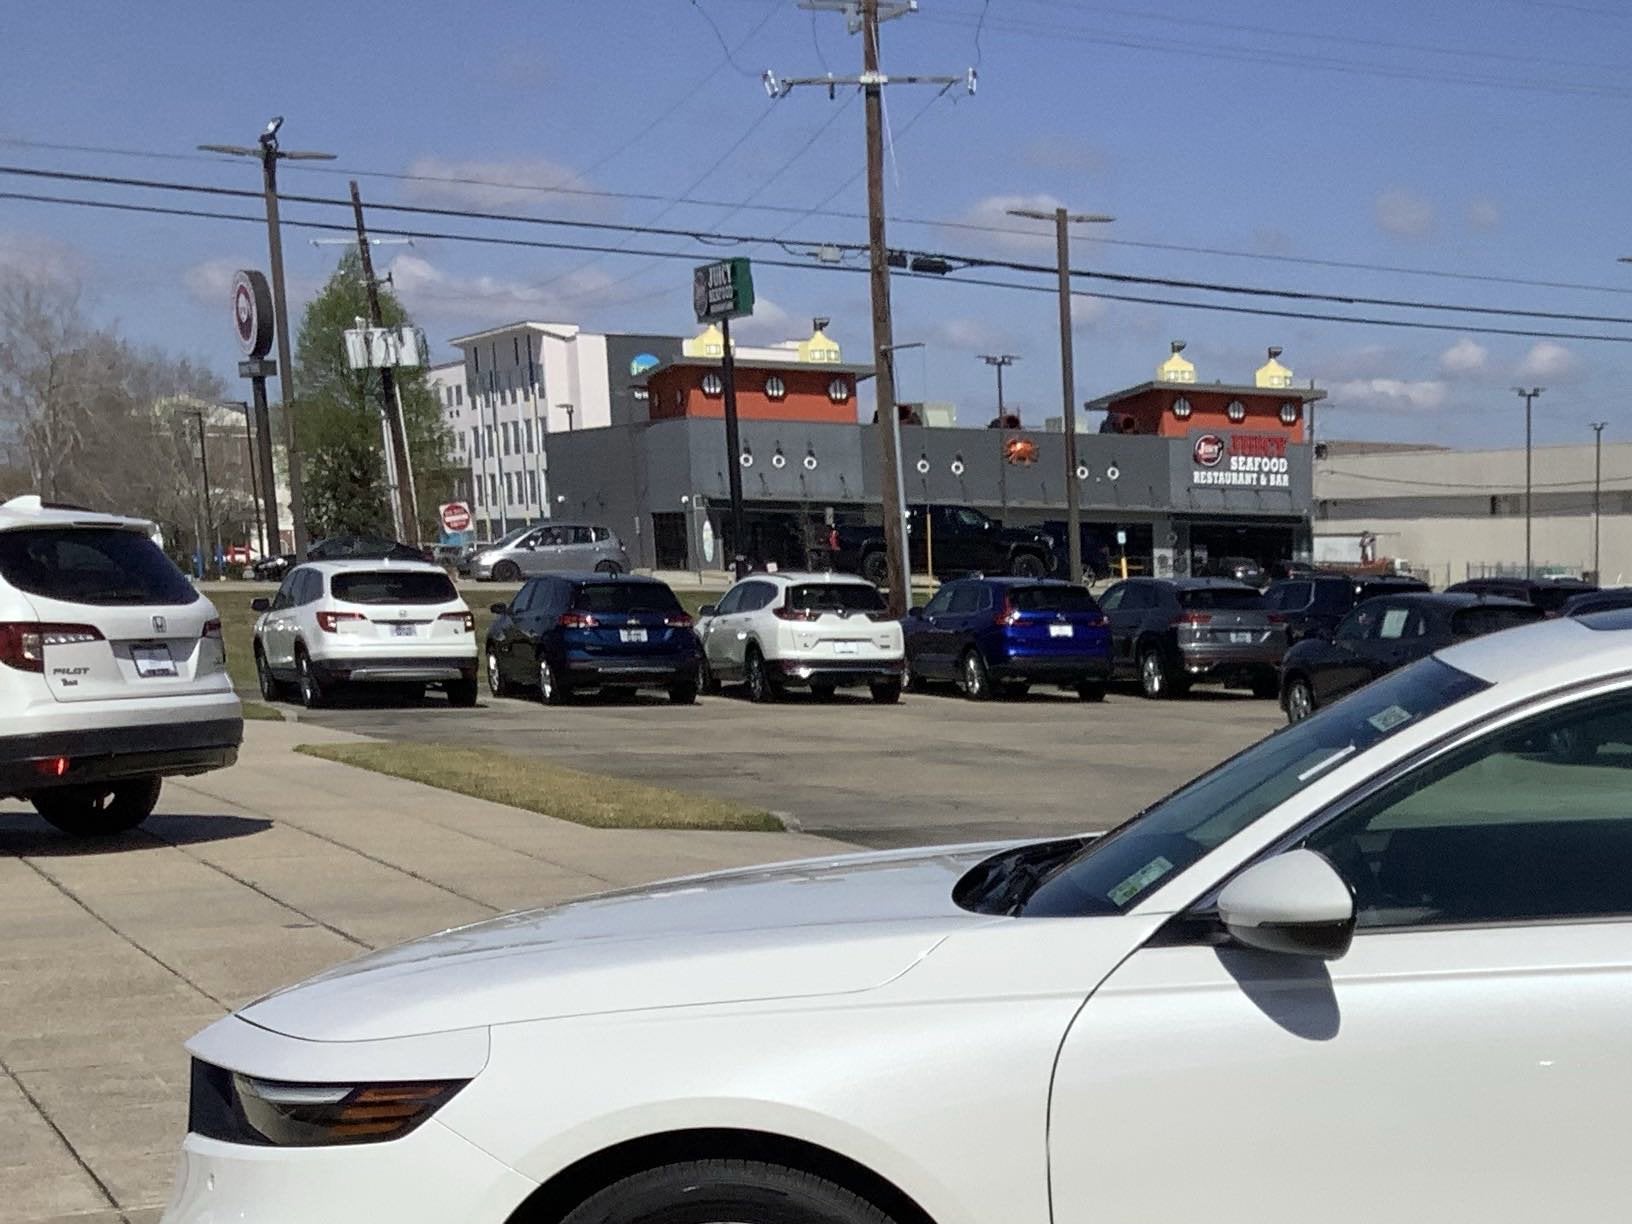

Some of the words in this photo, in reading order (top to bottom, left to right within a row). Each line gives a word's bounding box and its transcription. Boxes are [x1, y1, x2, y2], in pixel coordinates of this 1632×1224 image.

[1230, 456, 1288, 472] SEAFOOD
[1193, 471, 1257, 485] RESTAURANT
[1260, 474, 1267, 486] &
[1269, 474, 1289, 487] BAR
[53, 667, 90, 675] PILOT
